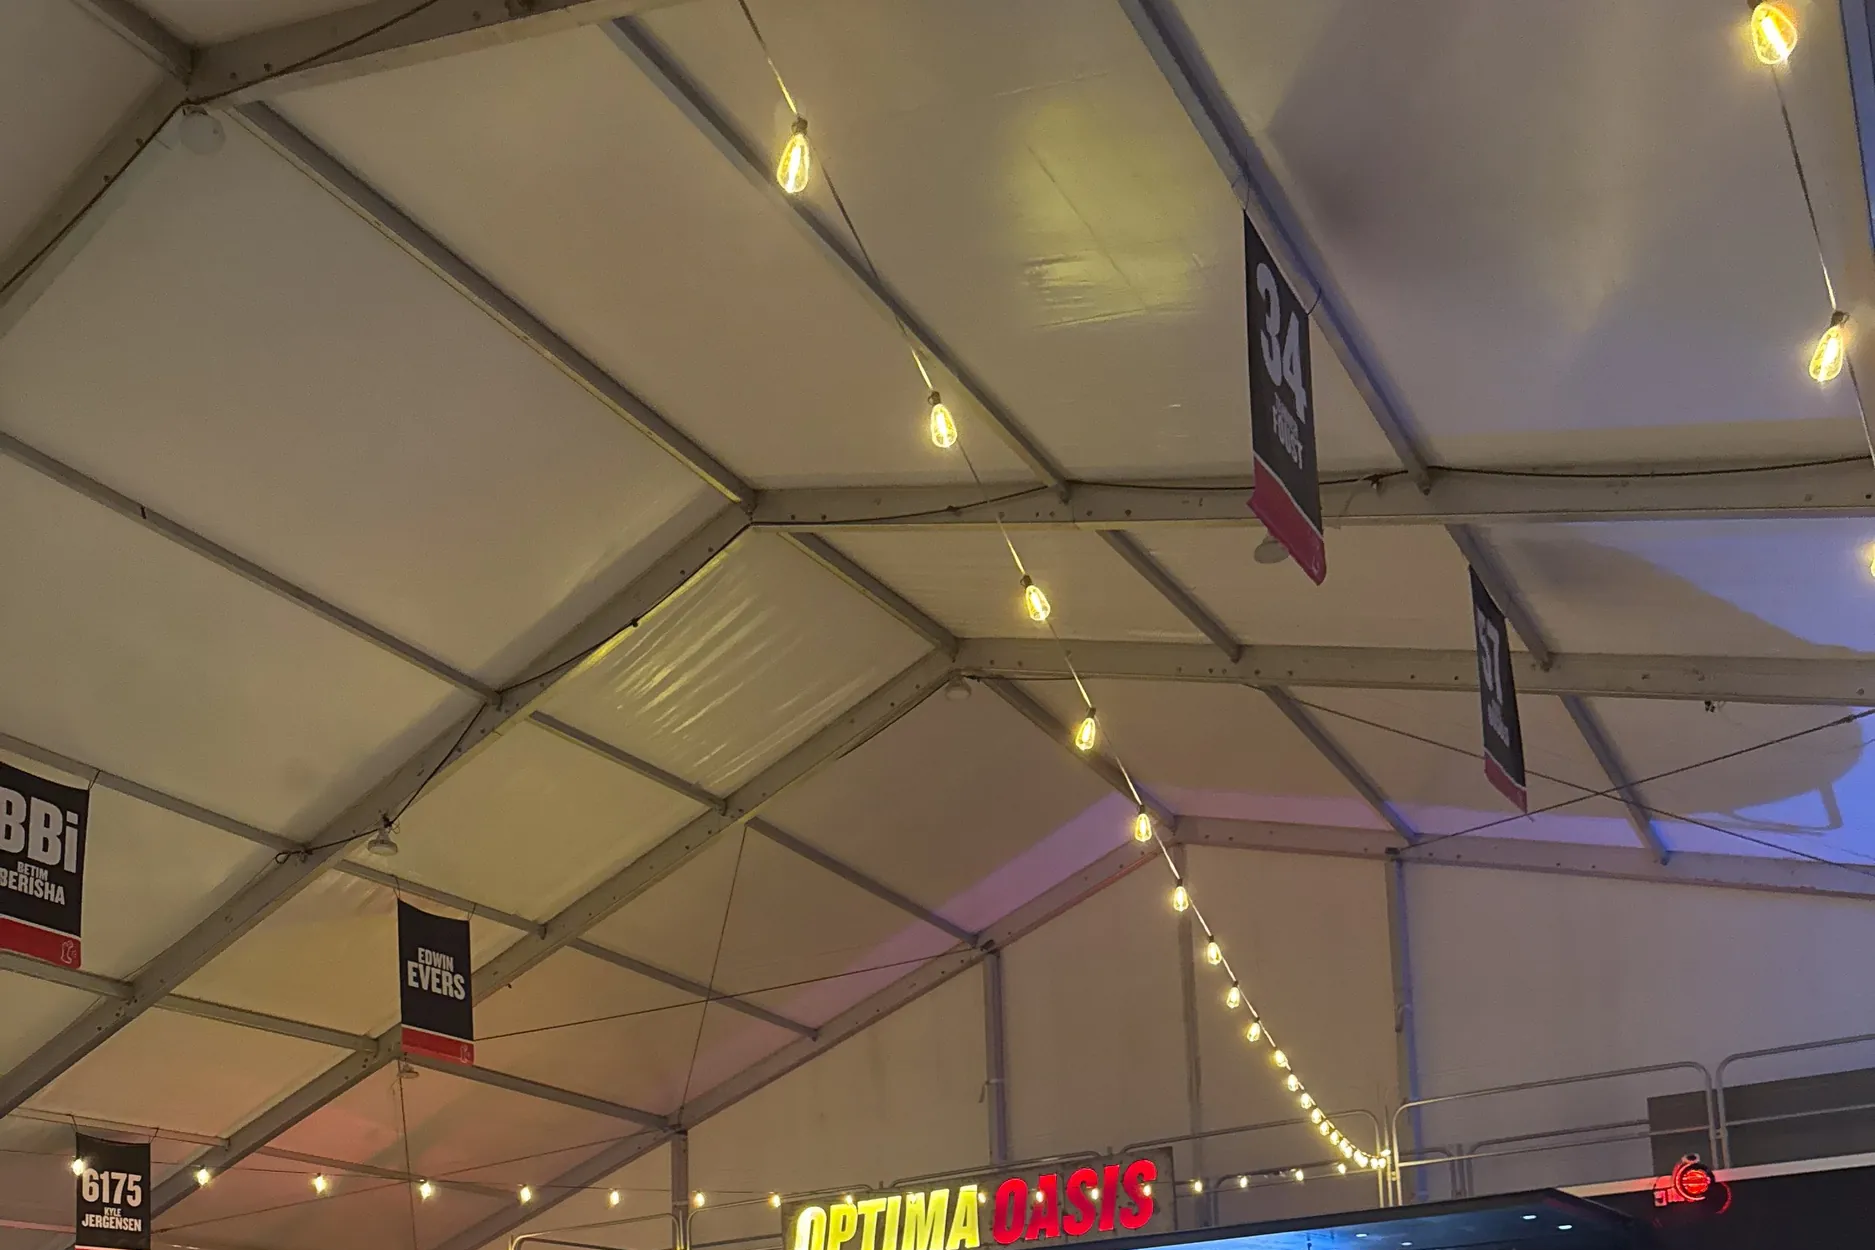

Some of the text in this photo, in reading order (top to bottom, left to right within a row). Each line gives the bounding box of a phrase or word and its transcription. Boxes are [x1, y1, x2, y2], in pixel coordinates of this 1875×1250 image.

[1256, 263, 1308, 424] 34
[0, 785, 79, 874] BBi
[0, 868, 66, 906] BERISHA
[17, 861, 49, 882] BETIM
[417, 947, 454, 973] EDWIN
[407, 960, 466, 1001] EVERS
[82, 1167, 142, 1207] 6175
[991, 1158, 1158, 1245] OASIS
[81, 1213, 142, 1232] JERGENSEN
[104, 1206, 122, 1217] KYLE
